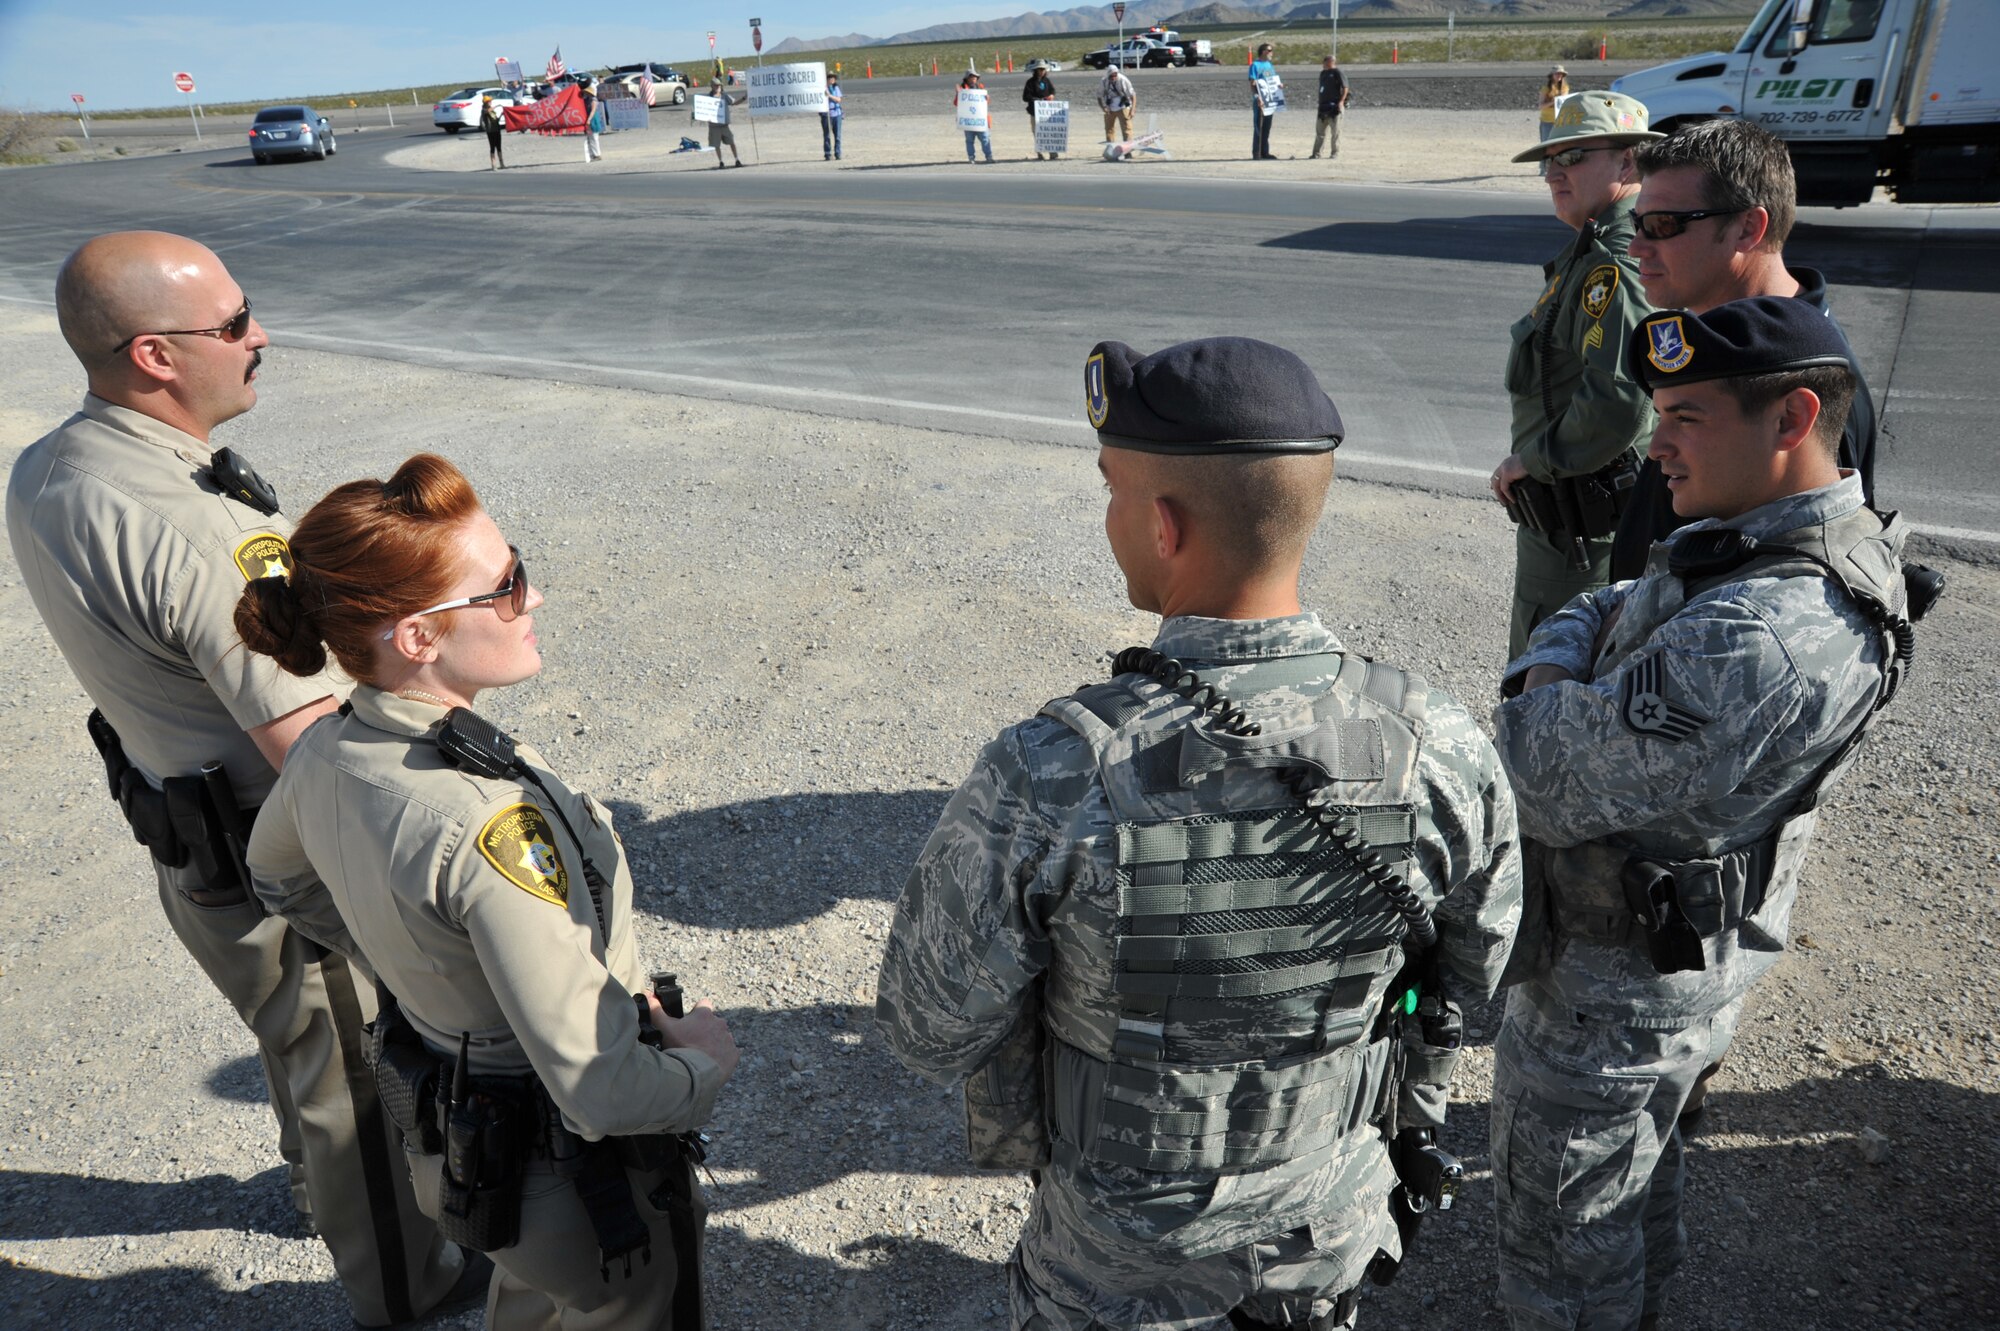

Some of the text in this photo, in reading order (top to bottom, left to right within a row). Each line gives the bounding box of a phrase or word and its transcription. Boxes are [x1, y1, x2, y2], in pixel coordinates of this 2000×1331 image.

[751, 74, 761, 86] ALL
[763, 73, 776, 86] LIFE
[778, 72, 785, 85] IS
[787, 71, 816, 84] SACRED
[1755, 78, 1852, 99] PILOT
[780, 96, 786, 106] &
[788, 93, 823, 106] CIVILIANS
[1759, 110, 1864, 123] 702-739-6772
[242, 540, 286, 560] METROPOLITAN
[256, 547, 280, 559] POLICE
[488, 811, 544, 848] METROPOLITAN
[507, 821, 537, 841] POLICE
[538, 882, 555, 896] LAS
